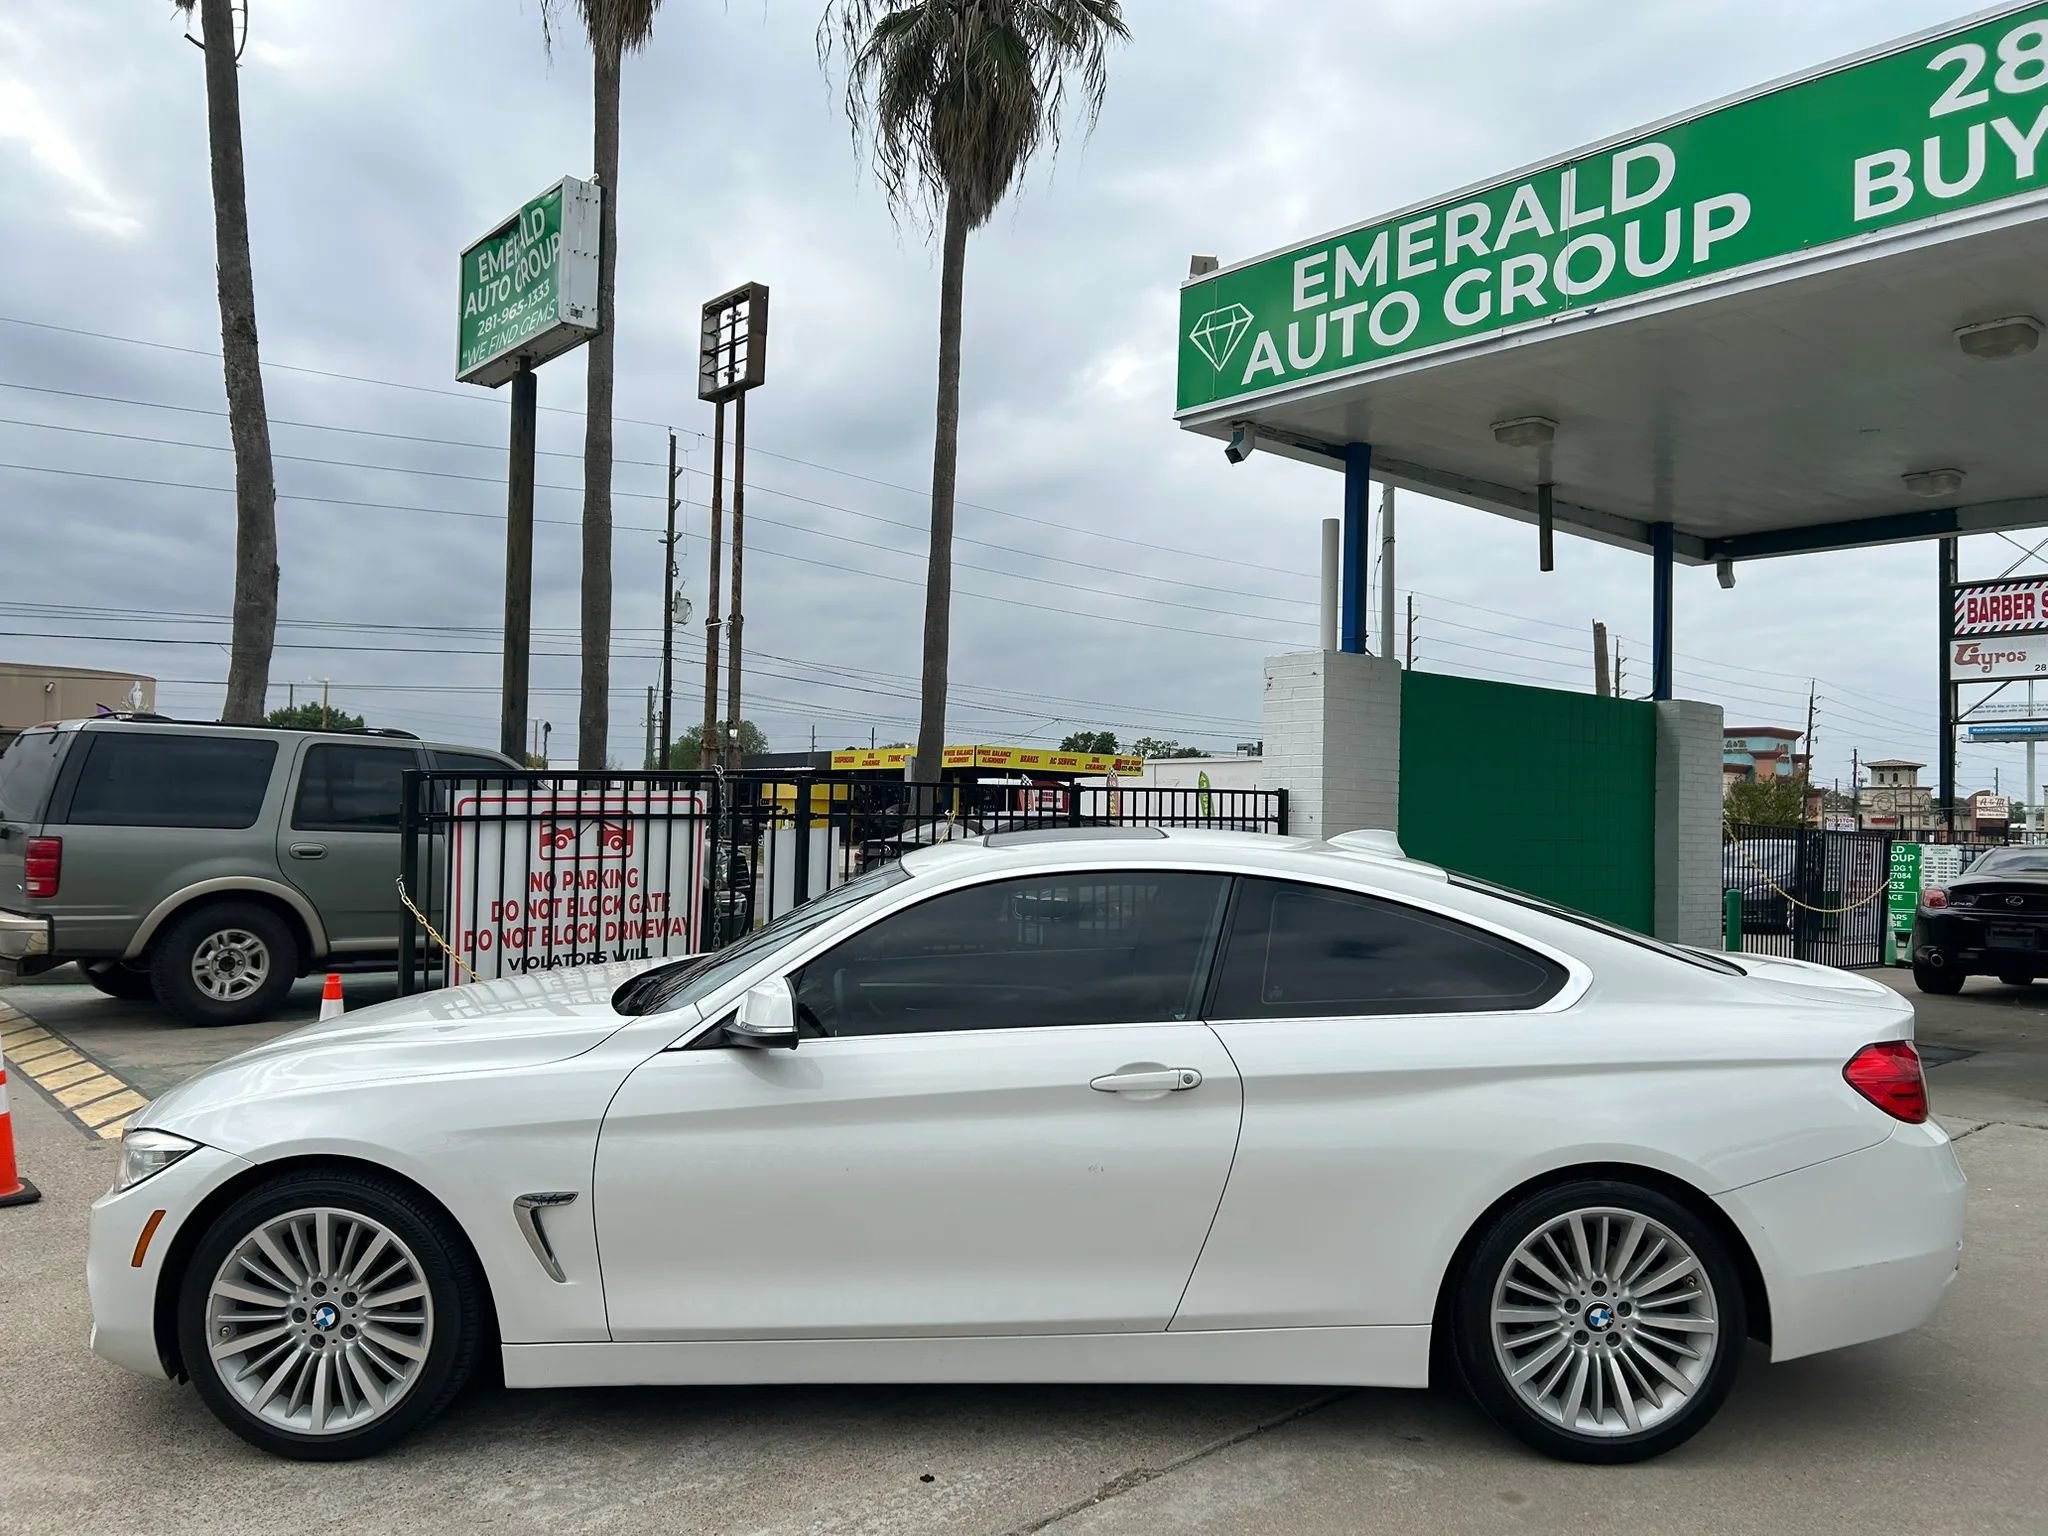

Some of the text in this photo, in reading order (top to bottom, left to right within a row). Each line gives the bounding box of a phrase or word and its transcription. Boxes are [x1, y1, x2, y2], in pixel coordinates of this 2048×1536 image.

[1926, 19, 2048, 119] 28
[1854, 104, 2048, 222] BUY
[478, 207, 545, 283] EMERALD
[1292, 142, 1676, 312] EMERALD
[464, 232, 560, 319] AUTO GROUP
[1241, 192, 1751, 386] AUTO GROUP
[477, 278, 550, 337] 281-965-1333
[488, 324, 518, 355] FIND
[1967, 592, 2035, 624] BARBER
[1954, 642, 2027, 674] Gyros
[2034, 663, 2047, 672] 28
[530, 867, 638, 893] NO PARKING
[491, 892, 671, 922] DO NOT BLOCK GATE
[464, 916, 690, 952] DO NOT BLOCK DRIVEWAY
[507, 947, 653, 971] VIOLATORS WILL
